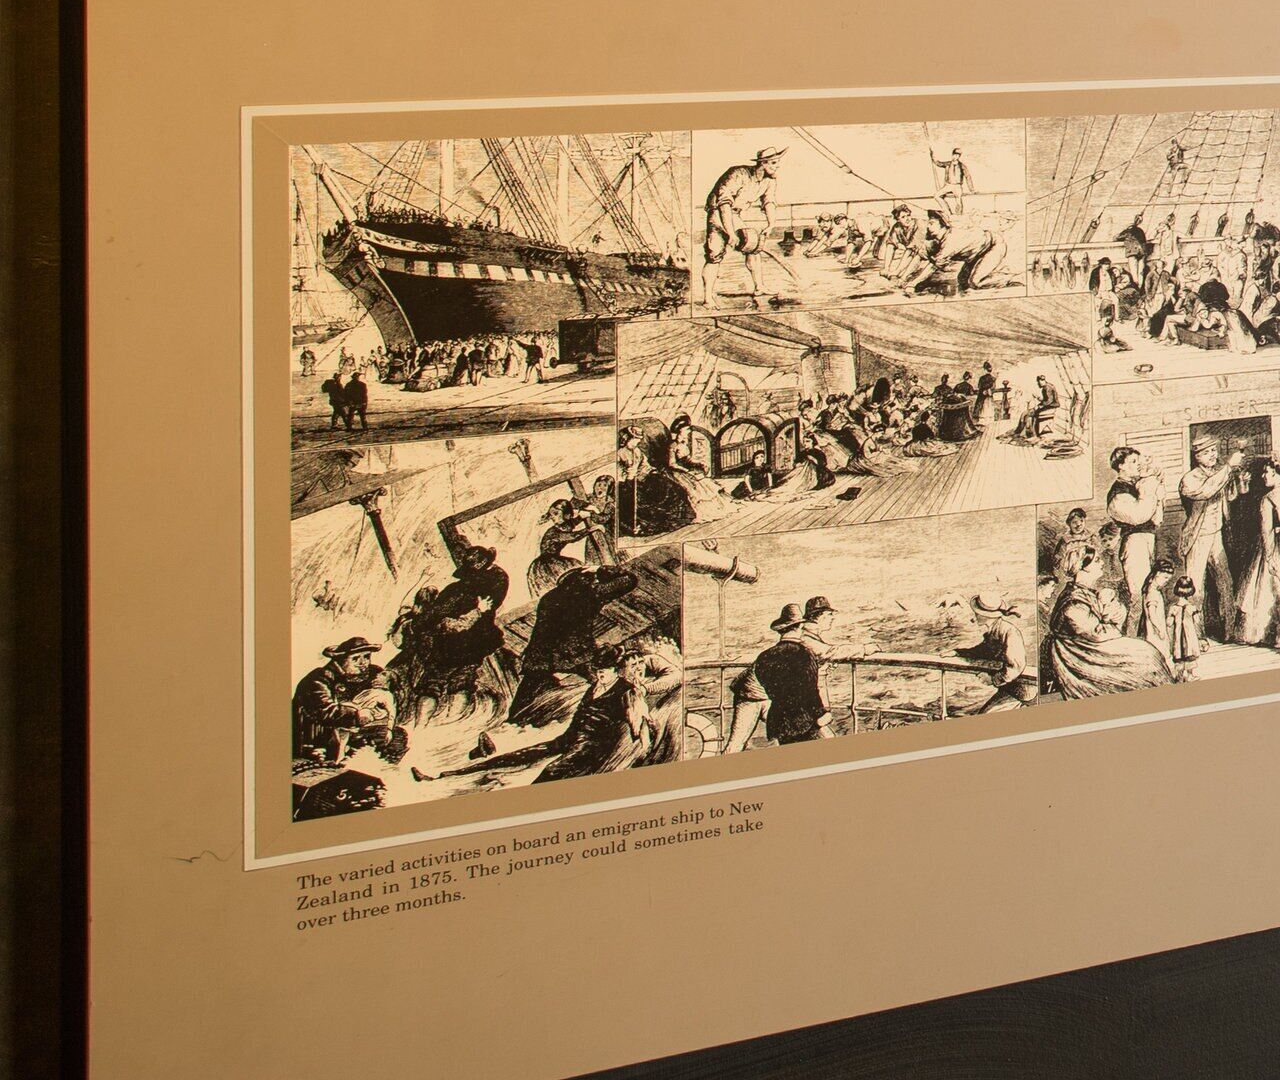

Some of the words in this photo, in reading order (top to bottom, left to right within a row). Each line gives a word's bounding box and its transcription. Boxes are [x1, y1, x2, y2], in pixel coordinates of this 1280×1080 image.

[296, 874, 332, 890] The
[338, 860, 395, 882] varied
[401, 848, 481, 871] activities
[486, 845, 506, 856] on
[512, 831, 560, 851] board
[566, 831, 586, 842] an
[592, 815, 666, 838] emigrant
[671, 809, 704, 825] ship
[709, 807, 724, 819] to
[729, 801, 764, 816] New
[297, 884, 373, 911] Zealand
[382, 881, 400, 895] in
[410, 870, 457, 890] 1875.
[466, 864, 500, 879] The
[506, 852, 574, 875] journey
[582, 839, 627, 859] could
[634, 828, 721, 850] sometimes
[728, 819, 763, 835] take
[297, 915, 337, 930] over
[342, 905, 390, 922] three
[395, 890, 466, 912] months.
